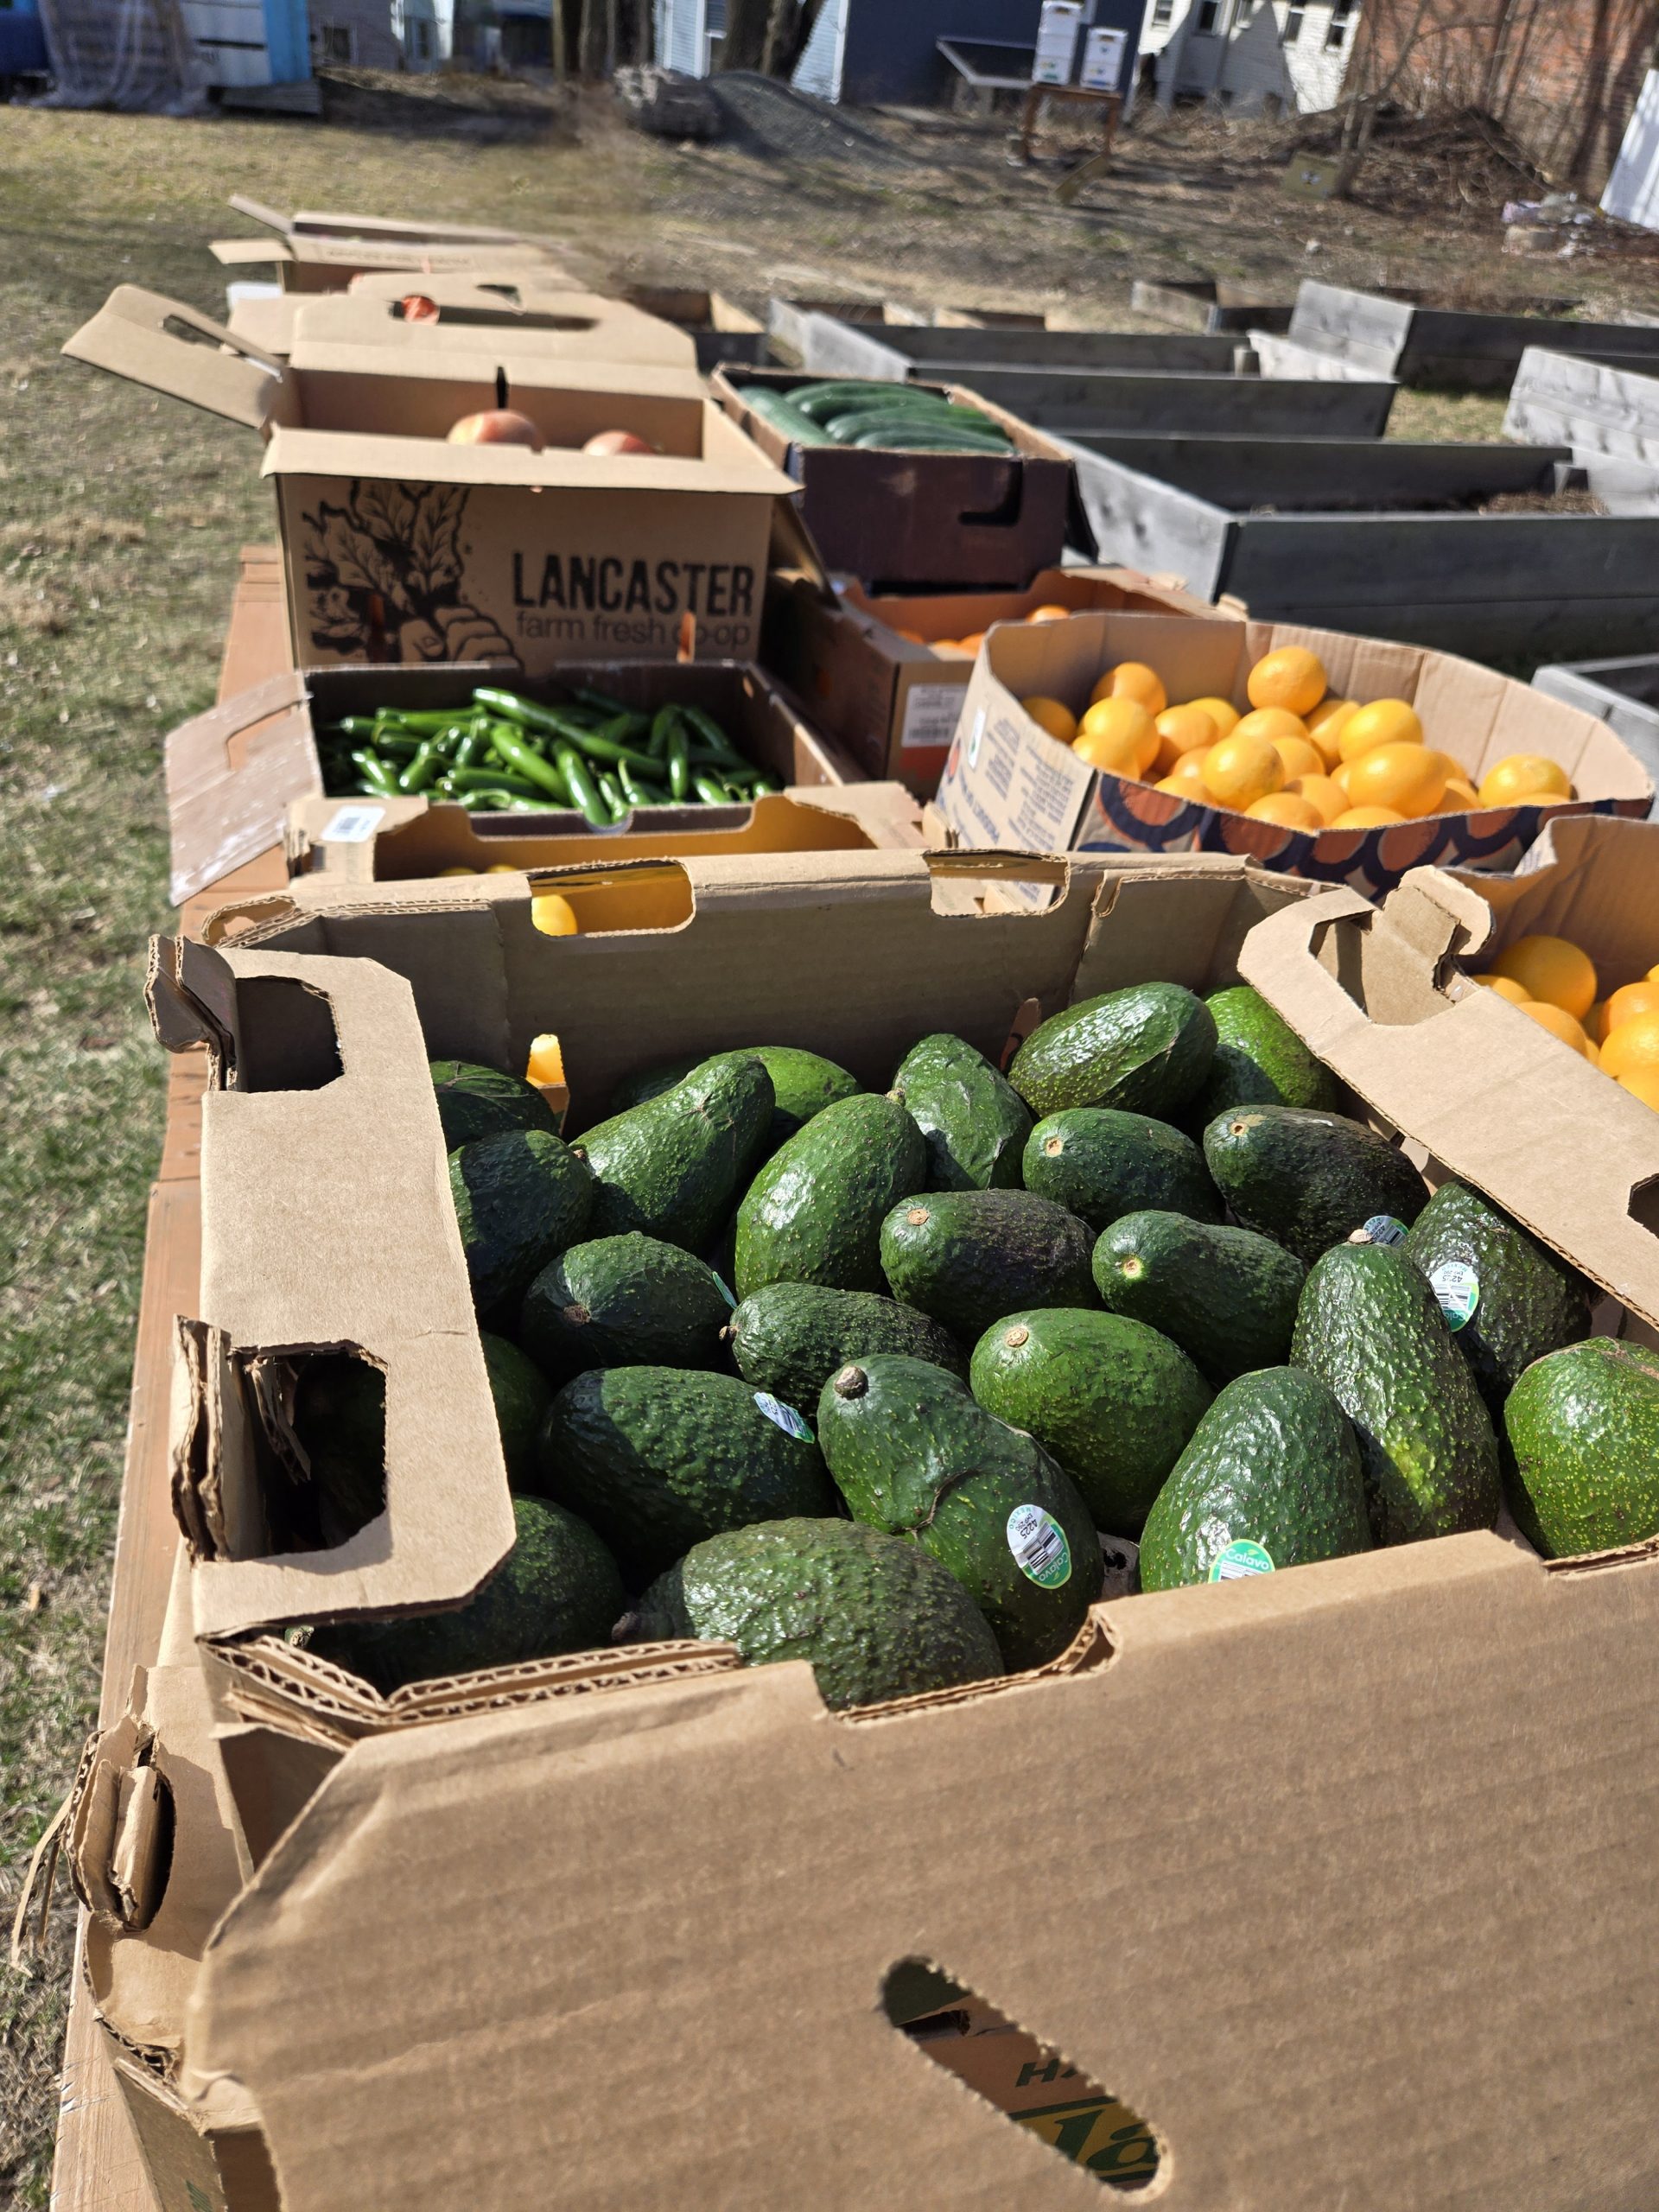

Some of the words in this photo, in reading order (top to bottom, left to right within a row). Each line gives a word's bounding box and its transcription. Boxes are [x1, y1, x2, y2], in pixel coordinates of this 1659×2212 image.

[513, 552, 754, 617] LANCASTER
[517, 612, 586, 640] farm
[594, 614, 666, 644] fresh
[1008, 1506, 1033, 1529] MEXICO
[1020, 1518, 1038, 1540] 4225
[1039, 1552, 1068, 1581] Calavo
[1226, 1548, 1269, 1570] Calavo
